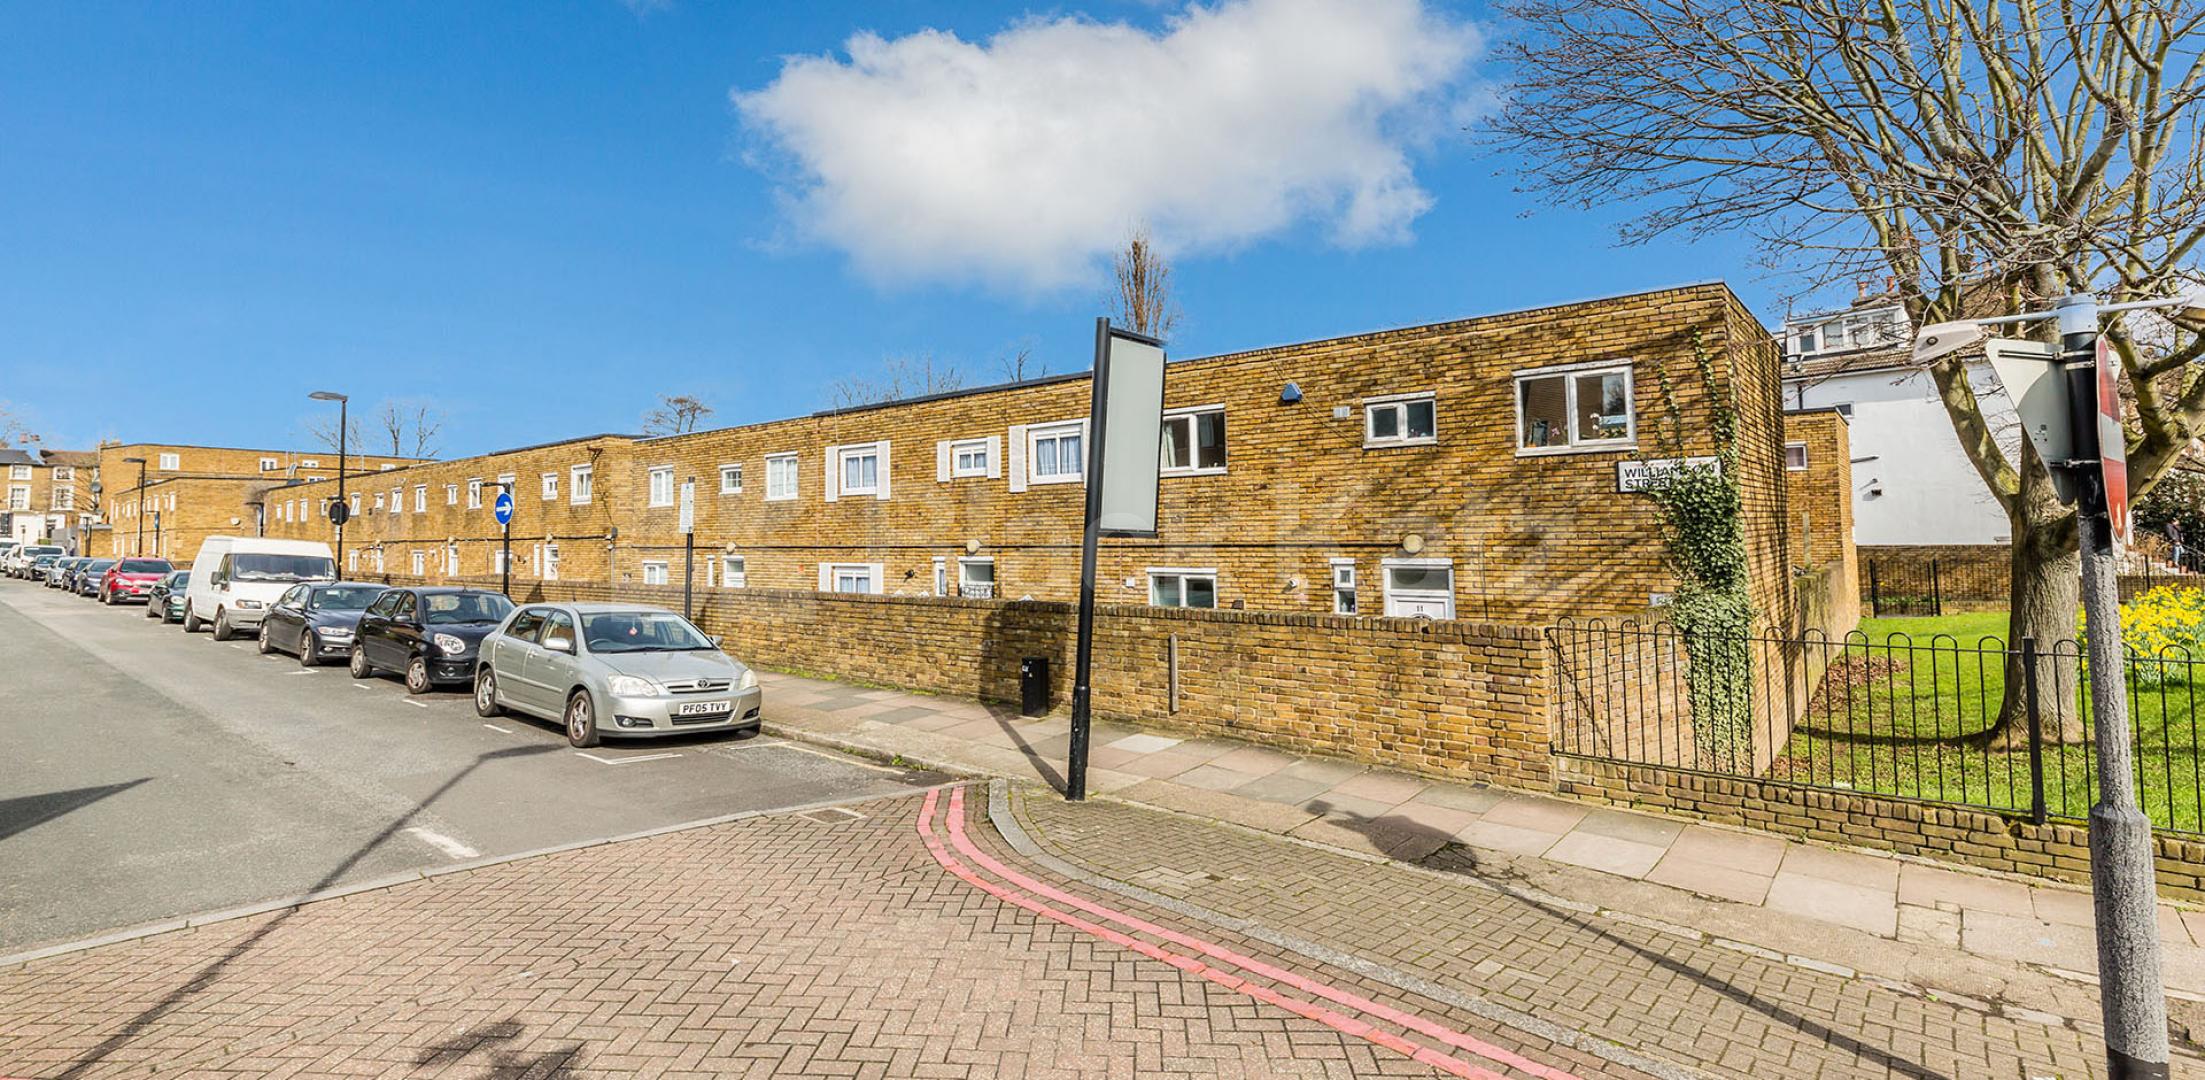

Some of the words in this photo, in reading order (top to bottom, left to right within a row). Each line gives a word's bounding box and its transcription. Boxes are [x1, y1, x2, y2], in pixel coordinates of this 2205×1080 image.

[1624, 463, 1715, 479] WILLIAMON
[682, 704, 708, 714] PF05
[710, 702, 728, 712] TVY
